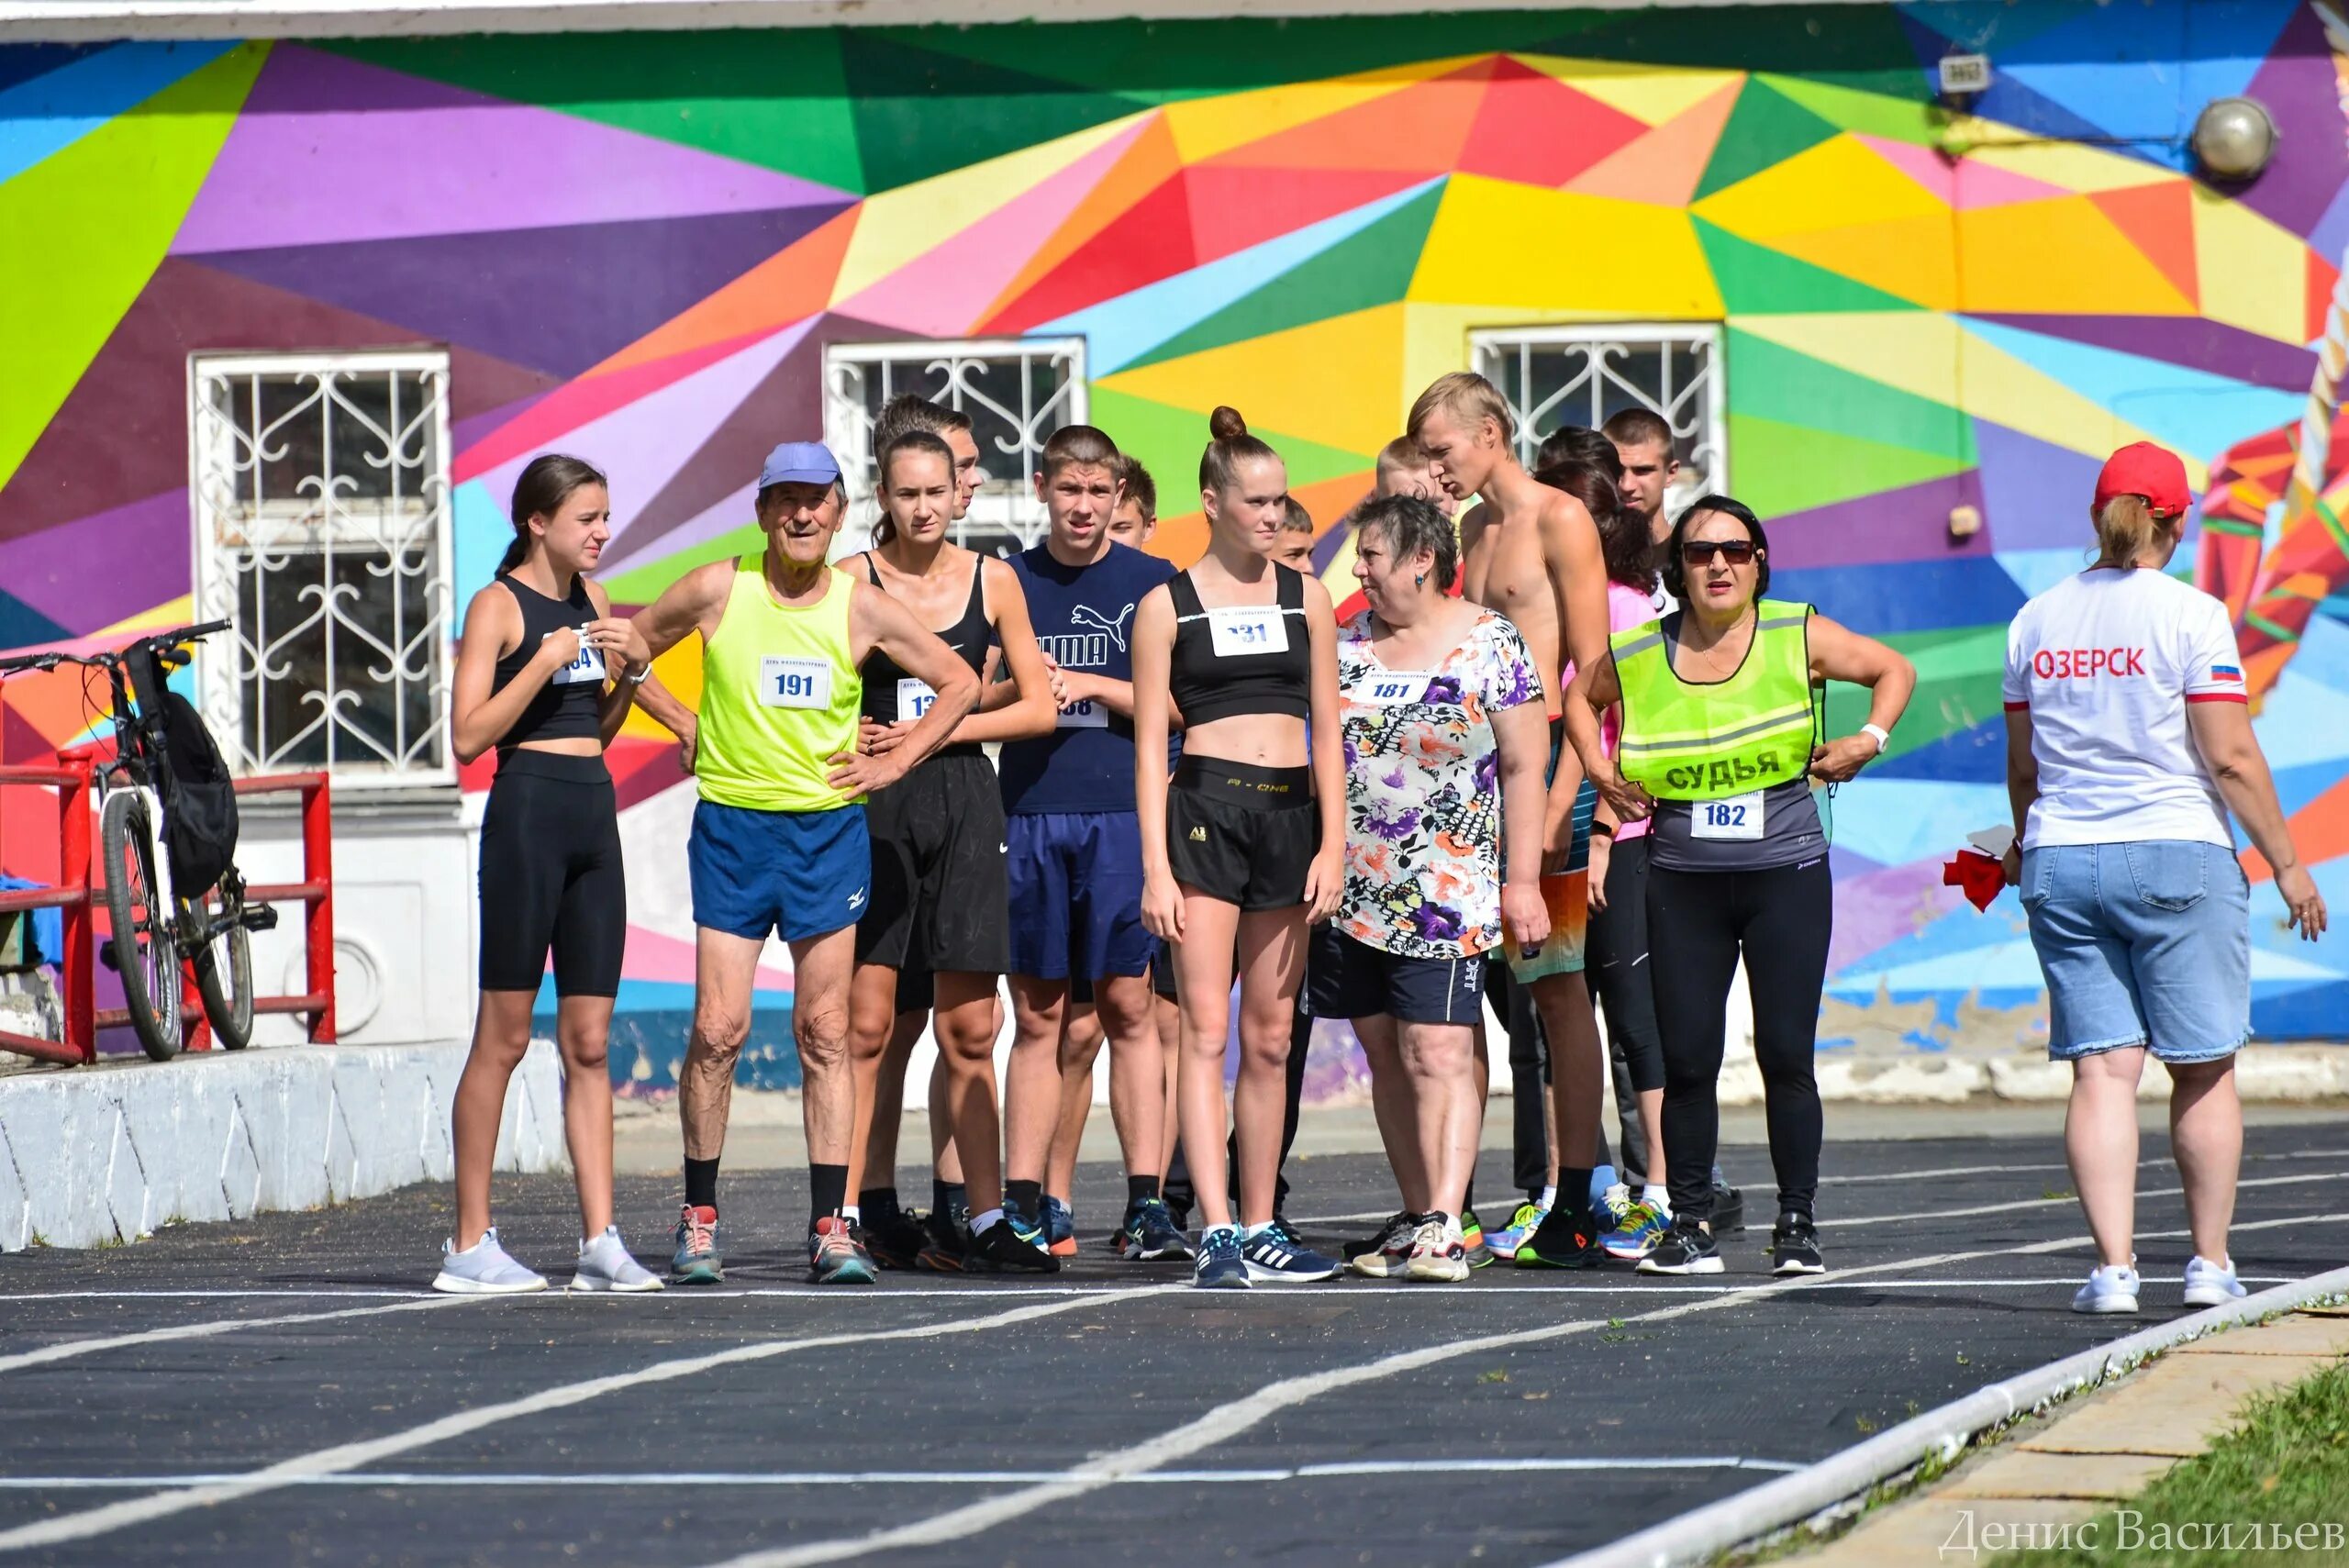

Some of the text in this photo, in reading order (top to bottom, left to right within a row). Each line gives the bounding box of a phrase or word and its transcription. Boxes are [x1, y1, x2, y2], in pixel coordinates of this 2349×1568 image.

[1035, 634, 1108, 667] MA
[2033, 648, 2145, 679] ОЗЕРСК
[774, 674, 813, 696] 191
[1374, 684, 1410, 698] 181
[1666, 751, 1780, 792] СУДЬЯ
[1705, 805, 1746, 826] 182
